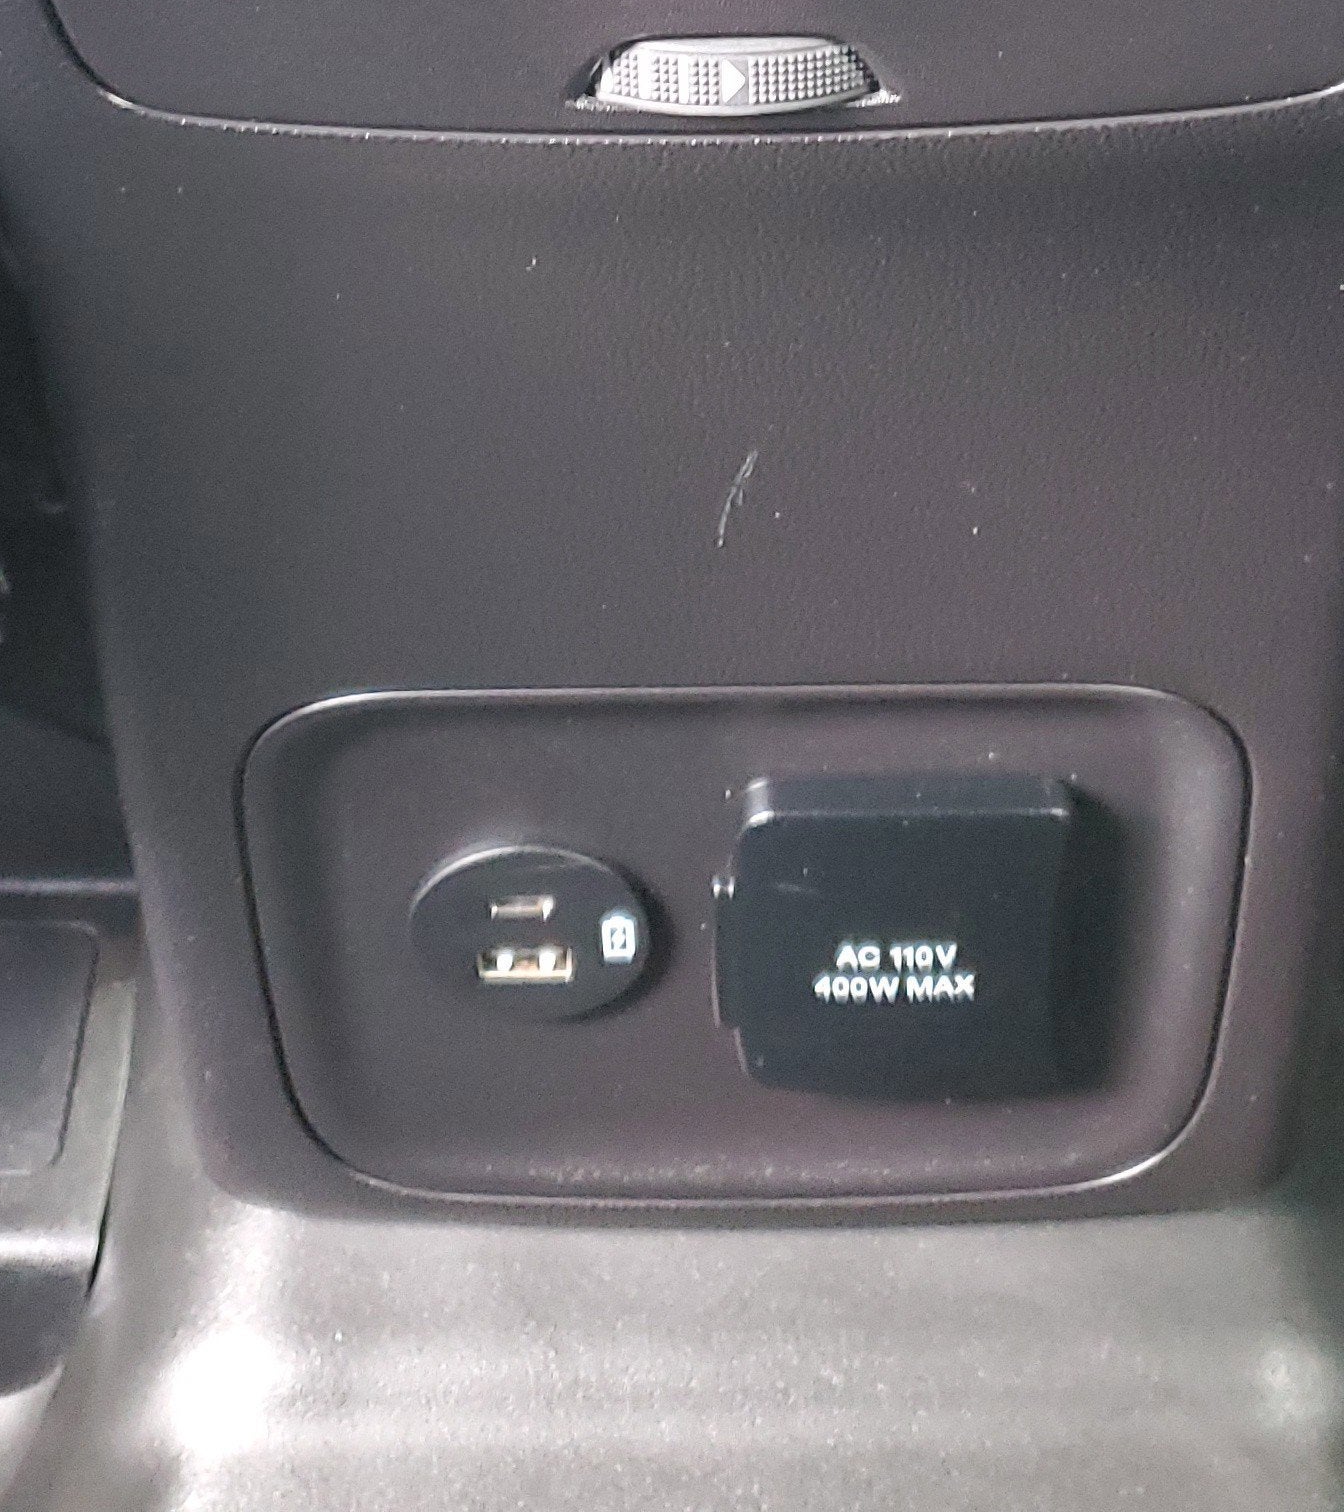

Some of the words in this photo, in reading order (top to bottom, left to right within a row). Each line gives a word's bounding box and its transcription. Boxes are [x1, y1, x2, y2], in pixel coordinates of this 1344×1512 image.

[835, 944, 881, 971] AC
[889, 944, 957, 971] 110V
[813, 974, 899, 1001] 400W
[906, 974, 975, 1001] MAX
